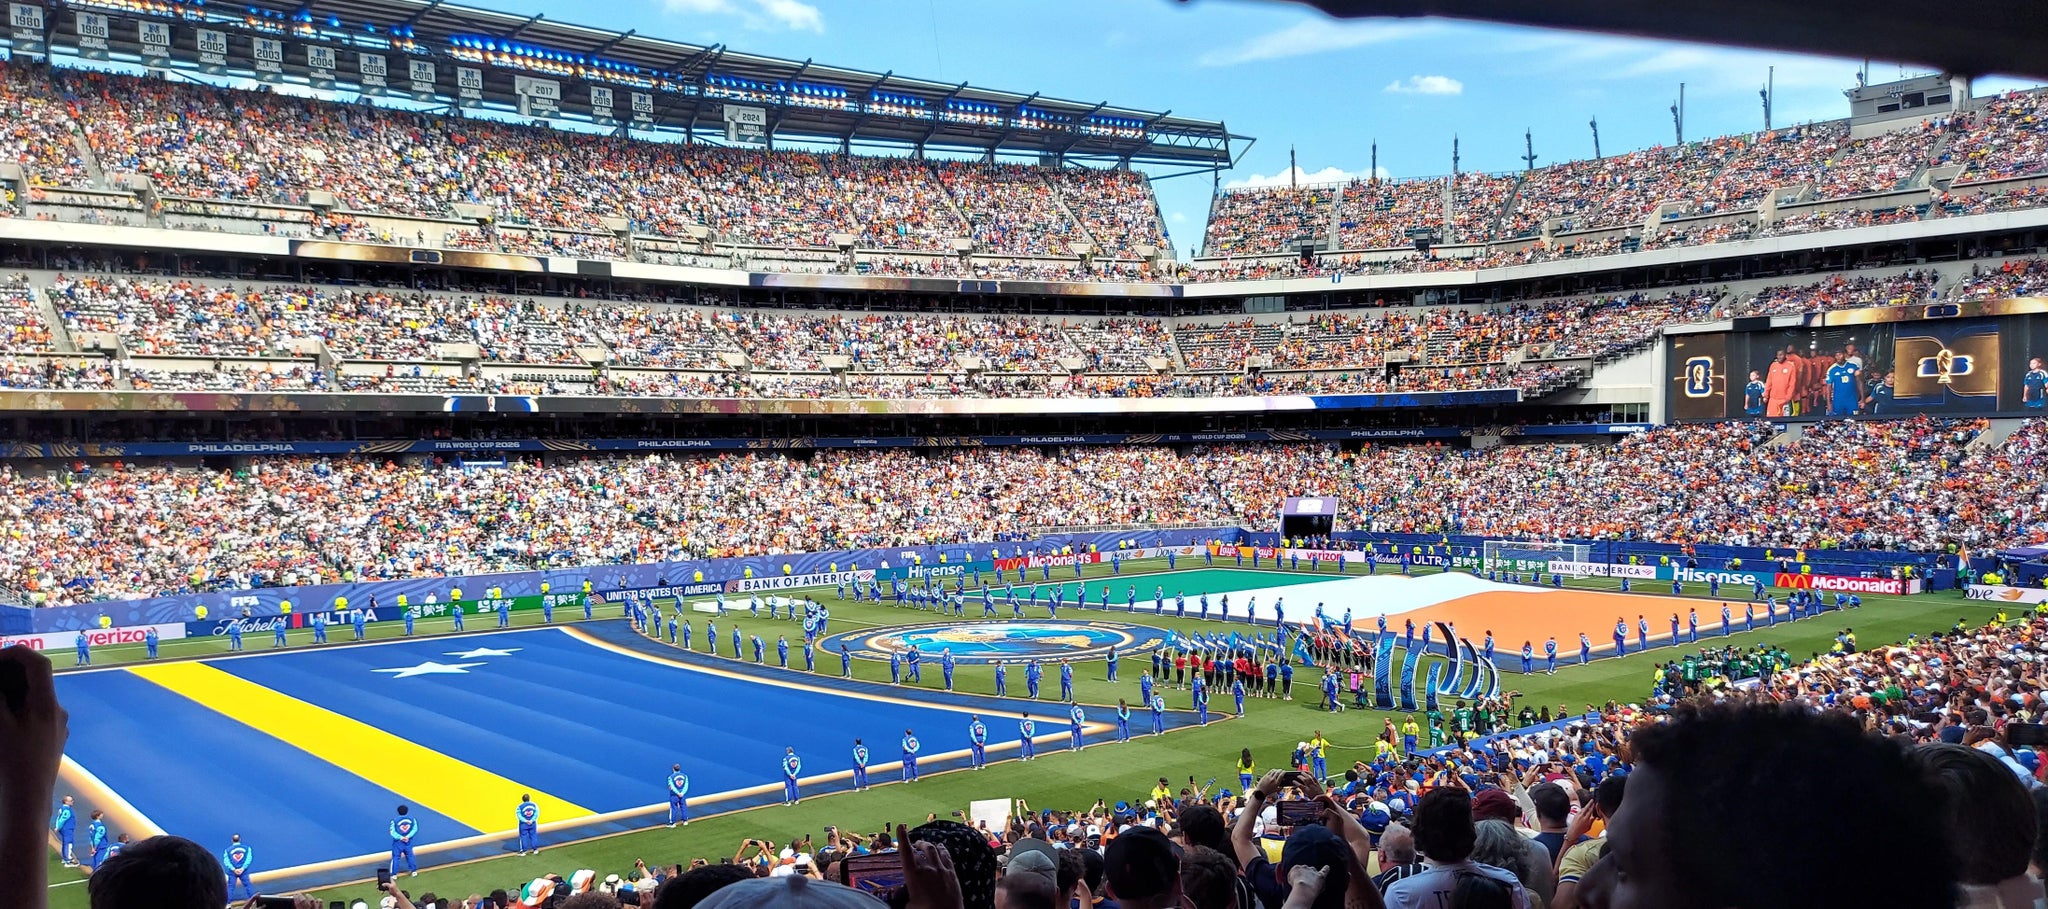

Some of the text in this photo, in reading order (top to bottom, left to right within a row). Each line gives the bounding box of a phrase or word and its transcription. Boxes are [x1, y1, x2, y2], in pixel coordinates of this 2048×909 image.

[14, 15, 40, 27] 1980
[81, 24, 105, 35] 1988
[143, 32, 167, 44] 2001
[200, 40, 225, 52] 2002
[256, 49, 280, 60] 2003
[310, 56, 333, 68] 2004
[363, 63, 385, 74] 2006
[413, 71, 432, 81] 2010
[461, 77, 480, 87] 2013
[535, 86, 553, 95] 2017
[634, 102, 652, 111] 2022
[742, 113, 760, 122] 2024
[1351, 429, 1425, 437] PHILADELPHIA
[188, 443, 295, 452] PHILADELPHIA
[495, 441, 520, 449] 2026
[1220, 544, 1236, 556] Lay's
[1258, 548, 1274, 558] ay's
[1673, 566, 1756, 585] Hisense
[744, 572, 857, 591] BANK OF AMERIC
[684, 583, 722, 595] AMERICA
[1966, 587, 1994, 600] ove
[231, 596, 260, 607] FIFA
